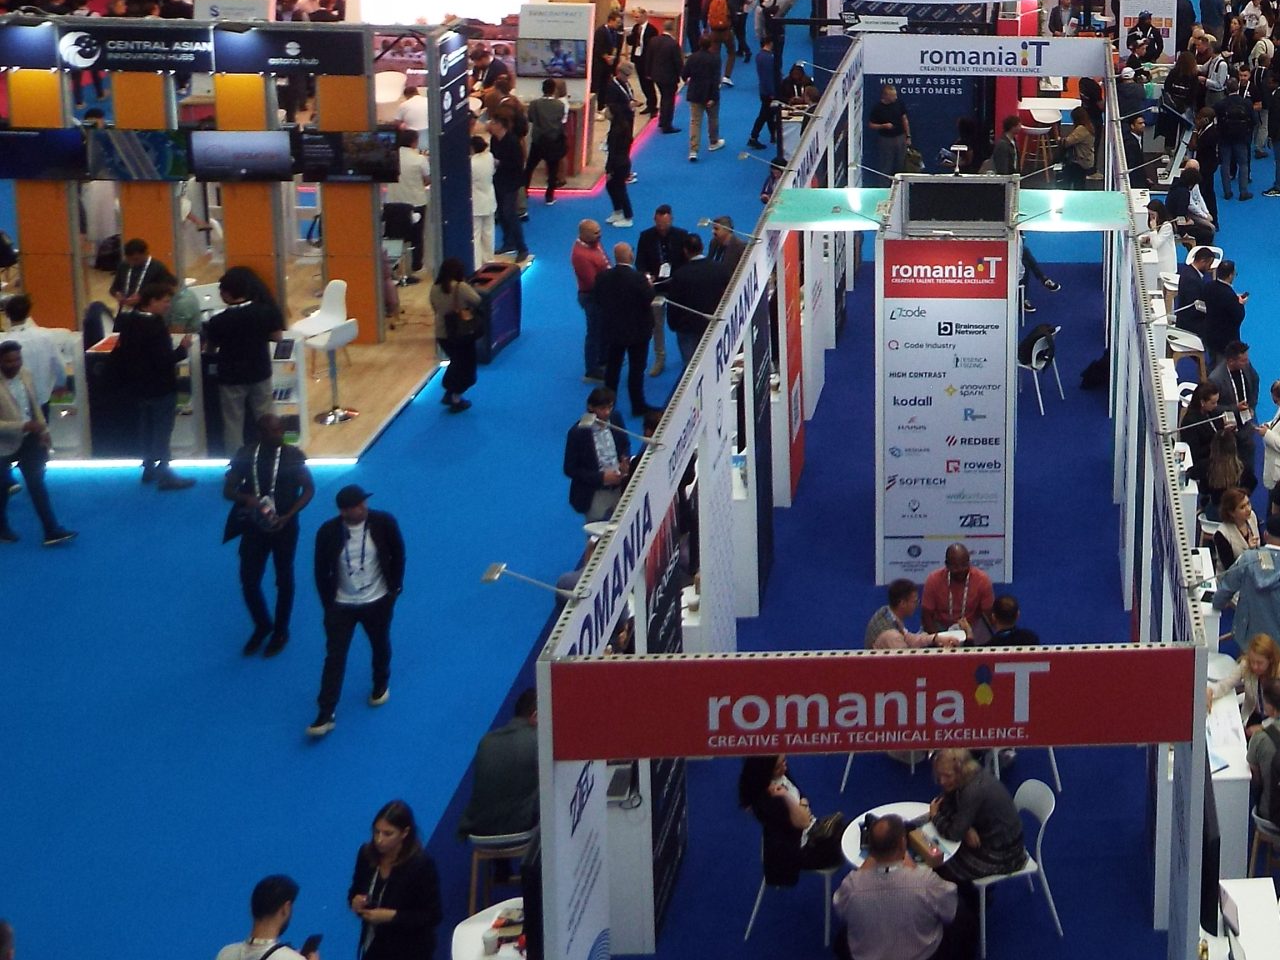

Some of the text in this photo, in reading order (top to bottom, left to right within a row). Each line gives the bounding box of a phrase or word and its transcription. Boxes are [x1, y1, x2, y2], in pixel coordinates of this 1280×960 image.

[107, 40, 213, 52] CENTRAL ASIAN
[107, 52, 195, 62] INNOVATION HUBS
[926, 78, 963, 86] ASSIST
[900, 87, 963, 95] CUSTOMERS
[925, 342, 956, 350] Industry
[893, 396, 932, 406] kodall
[960, 438, 1000, 446] REDBEE
[964, 460, 1001, 469] roweb
[899, 477, 946, 486] SOFTECH
[707, 726, 1030, 748] CREATIVE TALENT. TECHNICAL EXCELLENCE.
